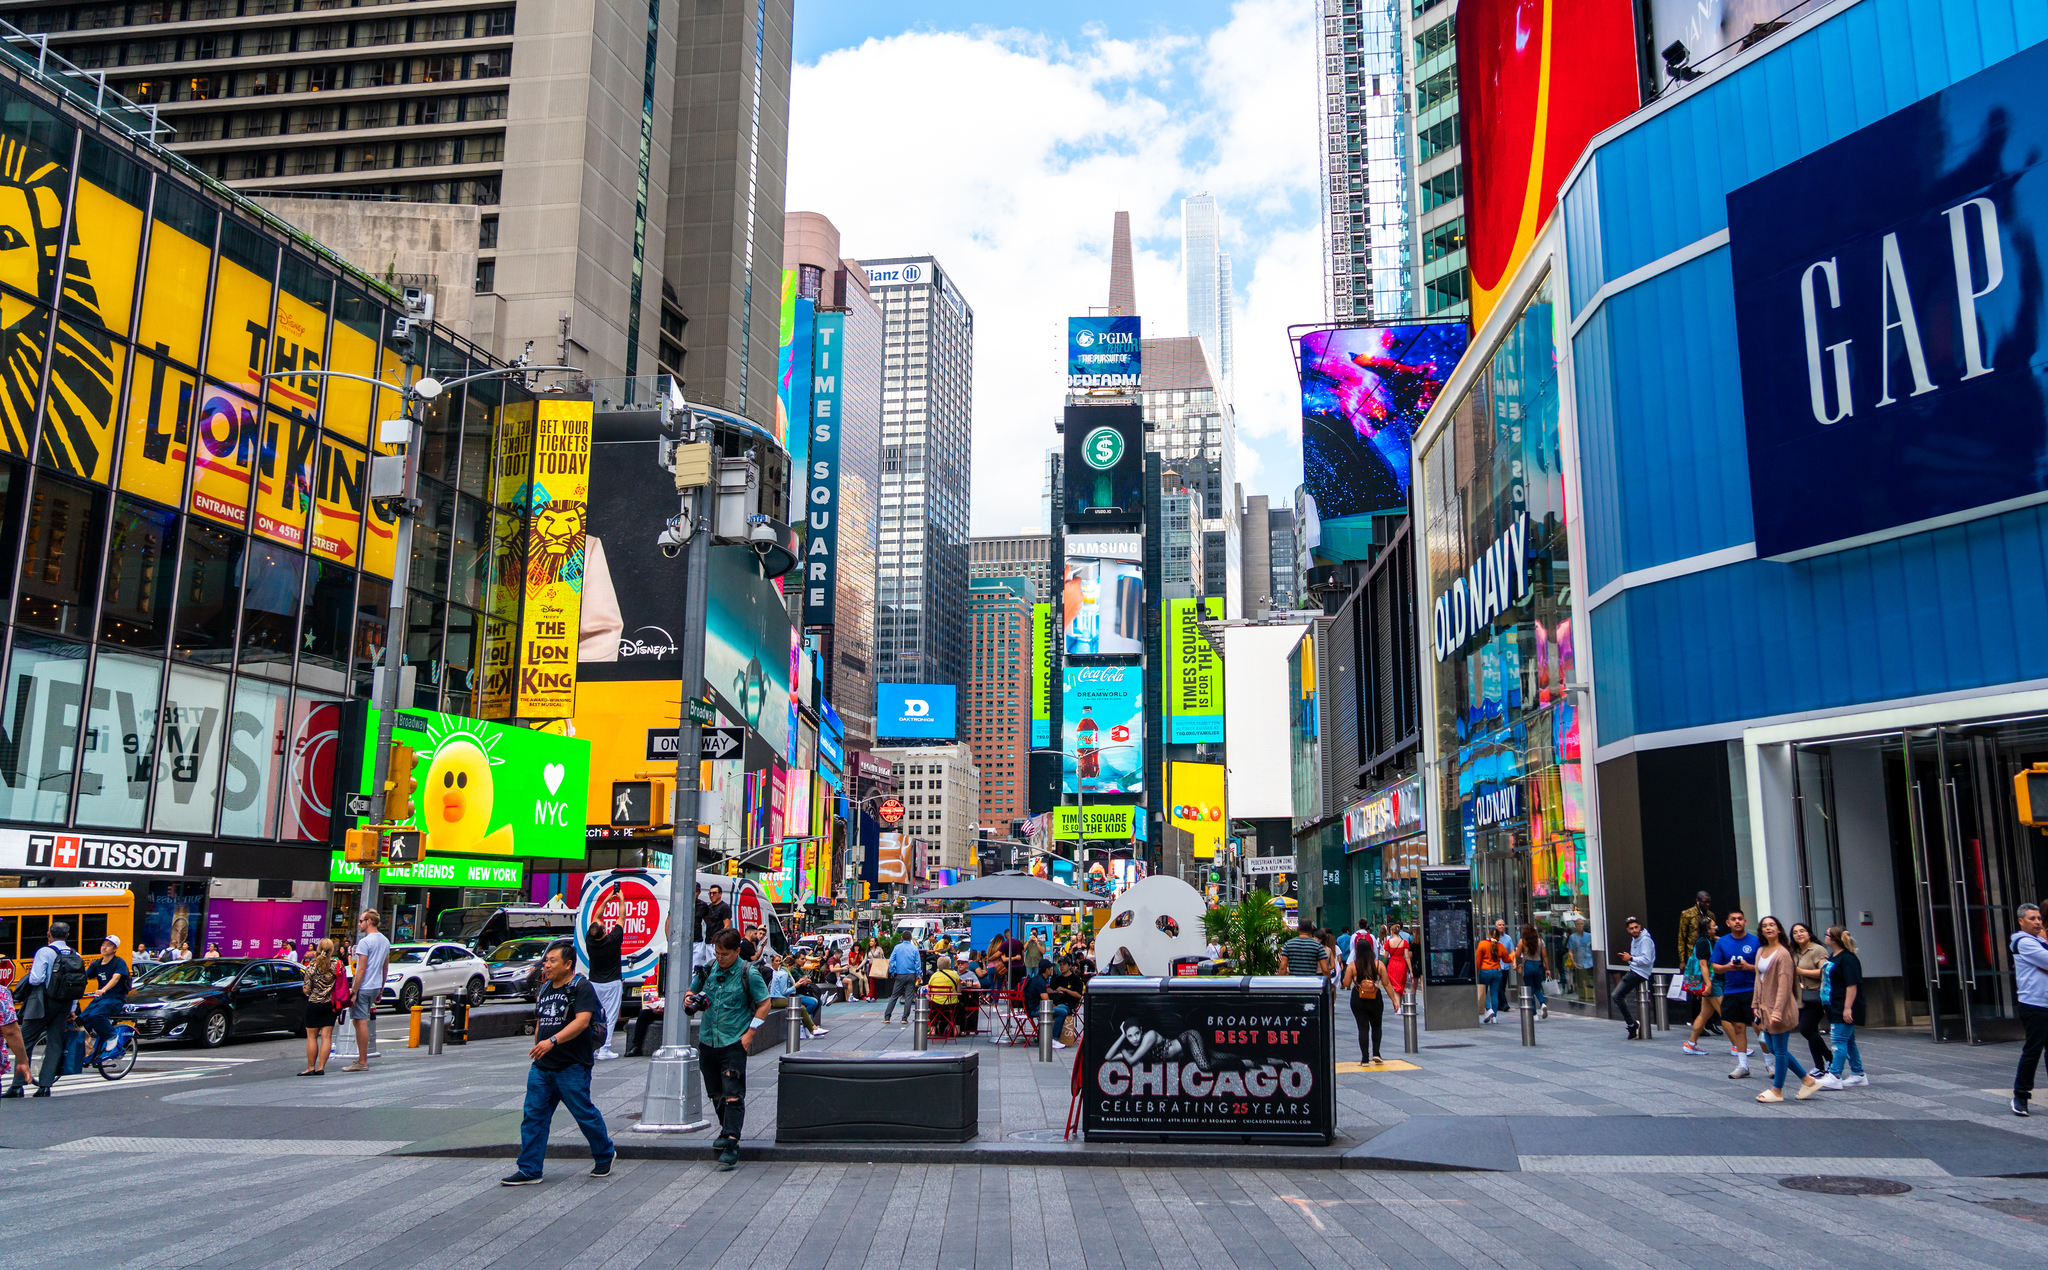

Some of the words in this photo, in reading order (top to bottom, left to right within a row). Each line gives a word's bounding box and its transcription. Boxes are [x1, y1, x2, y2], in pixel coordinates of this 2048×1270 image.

[866, 269, 899, 281] lianz
[1800, 197, 2004, 425] GAP
[1098, 333, 1133, 344] PGIM
[246, 319, 320, 398] THE
[814, 328, 834, 442] TIMES
[143, 342, 280, 479] LION
[540, 420, 558, 434] GET
[562, 420, 588, 434] YOUR
[540, 435, 588, 452] TICKETS
[538, 452, 587, 474] TODAY
[195, 495, 246, 521] ENTRANCE
[258, 517, 273, 531] ON
[279, 524, 300, 541] 45TH
[312, 535, 338, 553] STREET
[809, 461, 830, 607] SQUARE
[1068, 542, 1137, 553] SAMSUNG
[1434, 577, 1469, 662] OLD
[1470, 512, 1528, 636] NAVY
[540, 604, 563, 614] Disney
[536, 622, 565, 635] THE
[1182, 607, 1197, 666] SQUARE
[528, 641, 568, 665] LION
[617, 638, 678, 660] Disney+
[1199, 645, 1212, 671] THE
[521, 668, 571, 695] KING
[1183, 667, 1197, 710] TIMES
[1199, 675, 1209, 695] FOR
[690, 700, 715, 723] Broadway
[1199, 698, 1209, 707] IS
[399, 715, 426, 733] Broadway
[661, 738, 680, 750] ON
[702, 738, 729, 750] WAY
[353, 800, 364, 809] ONE
[535, 799, 568, 827] NYC
[1477, 794, 1492, 826] OLD
[1493, 784, 1517, 820] NAVY
[1062, 814, 1088, 823] TIMS
[1091, 813, 1126, 823] SQUARE
[1086, 823, 1102, 832] THE
[1105, 823, 1126, 832] KIDS
[84, 841, 177, 869] TISSOT
[386, 862, 410, 877] LINE
[412, 865, 454, 880] FRIENDS
[468, 866, 491, 881] NEW
[493, 868, 517, 882] YORK
[1329, 873, 1333, 881] NO
[95, 881, 131, 889] TISSOT
[603, 901, 648, 917] COVD-19
[0, 968, 12, 979] TOP
[1207, 1016, 1308, 1026] BROADWAY'S
[1215, 1030, 1259, 1044] BEST
[1267, 1031, 1300, 1044] BET
[1098, 1060, 1313, 1098] CHICAGO
[1101, 1100, 1228, 1113] CELEBRATING
[1232, 1102, 1248, 1114] 25
[1252, 1103, 1310, 1114] YEARS
